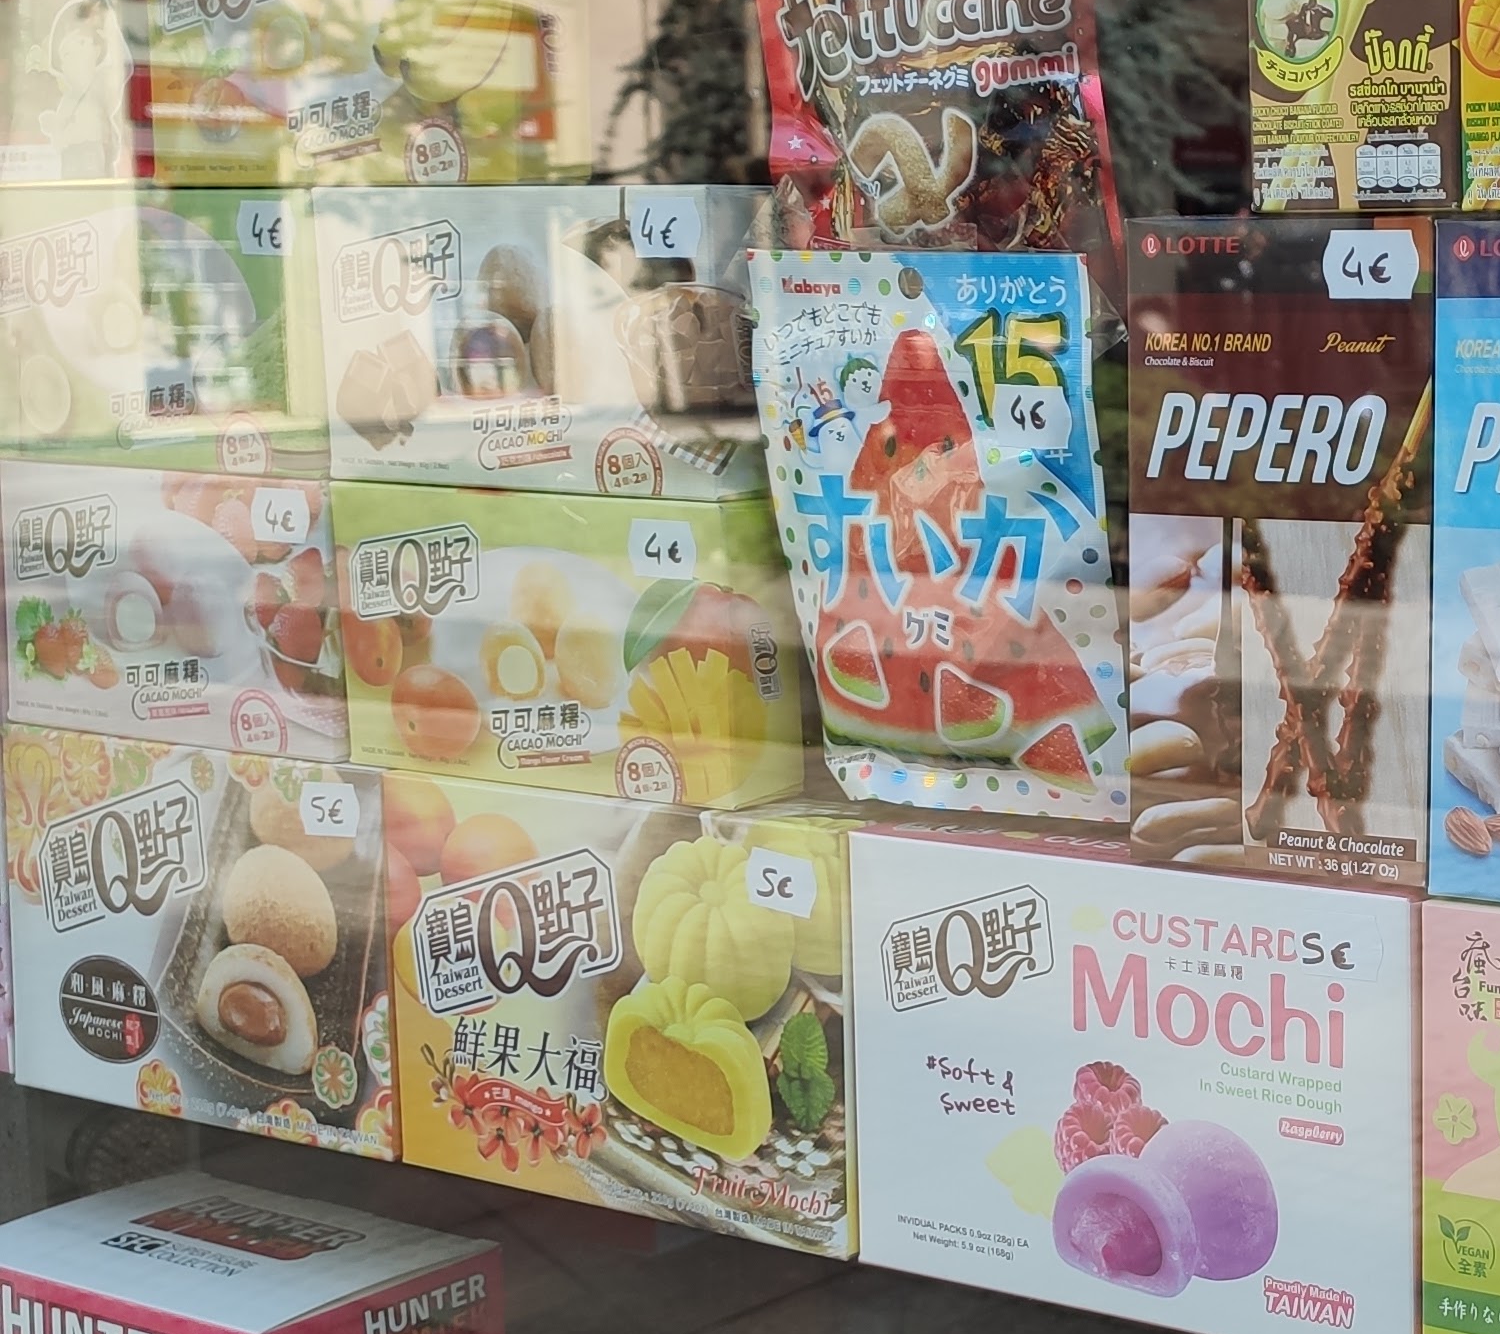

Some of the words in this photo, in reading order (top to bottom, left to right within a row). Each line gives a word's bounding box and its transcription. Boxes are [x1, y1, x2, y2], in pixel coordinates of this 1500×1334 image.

[857, 67, 970, 95] フェットチーネグミ
[972, 46, 1079, 97] gummi
[252, 213, 281, 248] 4€
[642, 208, 677, 248] 4€
[1166, 234, 1239, 256] LOTTE
[1341, 246, 1393, 285] 4€
[782, 277, 841, 295] Kabaya
[956, 274, 1068, 306] ありがとう
[1145, 332, 1190, 353] KOREA
[1192, 332, 1221, 353] NO.1
[1224, 332, 1272, 353] BRAND
[1319, 332, 1396, 355] Peanut
[1146, 392, 1387, 485] PEPERO
[265, 500, 295, 532] 4€
[644, 532, 682, 565] 4€
[794, 474, 1081, 622] すいか
[905, 611, 953, 646] グミ
[311, 796, 344, 824] 5€
[58, 888, 94, 907] Taiwan
[757, 868, 794, 899] 5€
[58, 901, 98, 922] Dessert
[1301, 932, 1355, 970] 5€
[432, 965, 479, 986] Taiwan
[434, 978, 483, 1002] Dessert
[896, 973, 937, 991] Taiwan
[896, 984, 939, 1004] Dessert
[1073, 945, 1344, 1069] Mochi
[87, 1026, 123, 1041] MOCHI
[452, 1016, 603, 1093] 鮮果大福
[1220, 1062, 1274, 1083] Custard
[1278, 1069, 1342, 1095] Wrapped
[940, 1093, 1016, 1116] Sweet
[897, 1215, 937, 1230] INVIDUAL
[939, 1223, 968, 1236] PACKS
[1017, 1238, 1029, 1248] EA
[1456, 1246, 1490, 1262] VEGAN
[1264, 1296, 1353, 1329] TAIWAN
